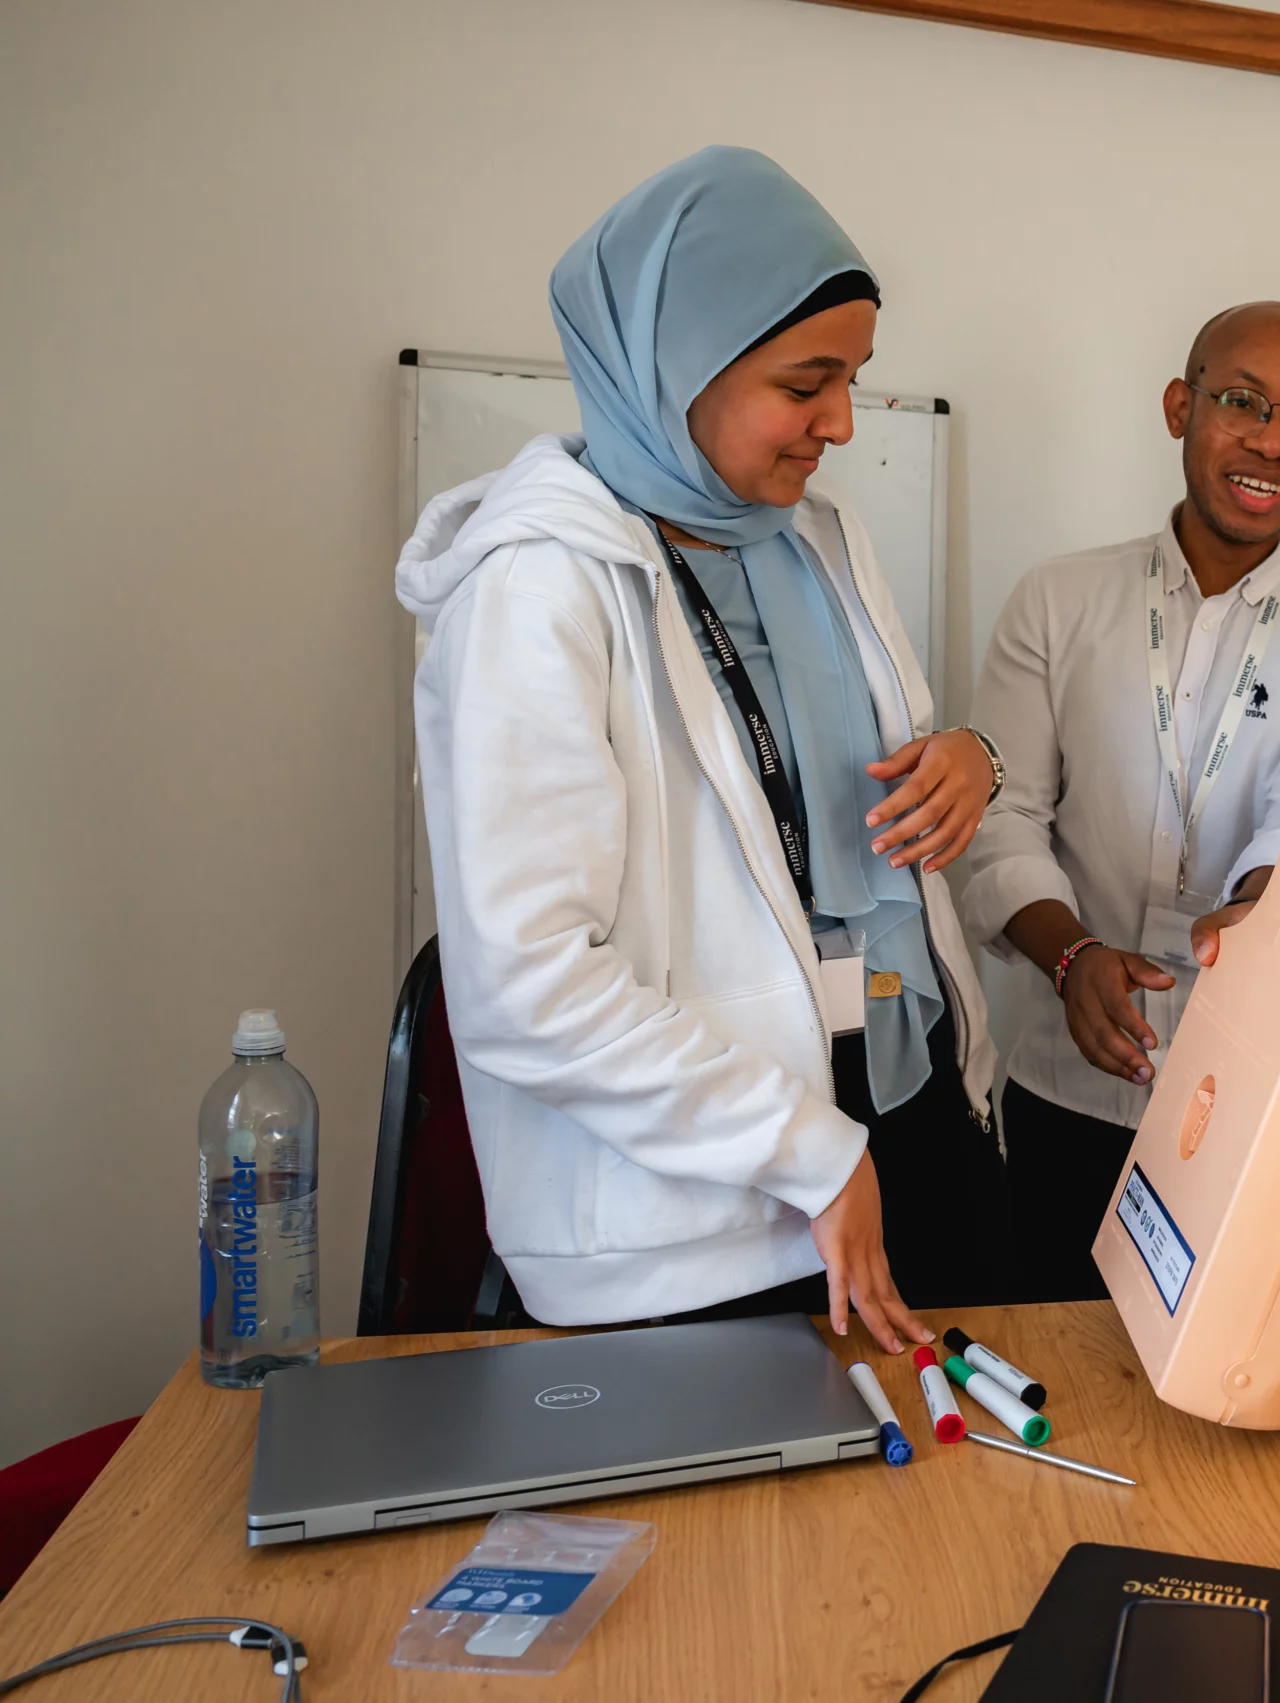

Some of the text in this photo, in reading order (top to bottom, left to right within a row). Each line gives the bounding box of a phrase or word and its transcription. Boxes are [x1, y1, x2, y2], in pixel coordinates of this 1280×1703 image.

[1150, 608, 1160, 650] immerse
[1258, 595, 1277, 625] immerse
[701, 609, 735, 667] immerse
[715, 619, 734, 653] EDUCATION
[1232, 653, 1256, 698] immerse
[1156, 685, 1168, 732] immerse
[1245, 709, 1268, 720] USPA
[749, 713, 777, 775] immerse
[763, 723, 779, 759] EDUCATION
[1204, 731, 1228, 778] immerse
[780, 821, 802, 876] mmerse
[232, 1155, 257, 1337] smartwater
[544, 1391, 594, 1403] DELL
[1122, 1580, 1270, 1612] immerse
[1158, 1576, 1243, 1594] EDUCATION
